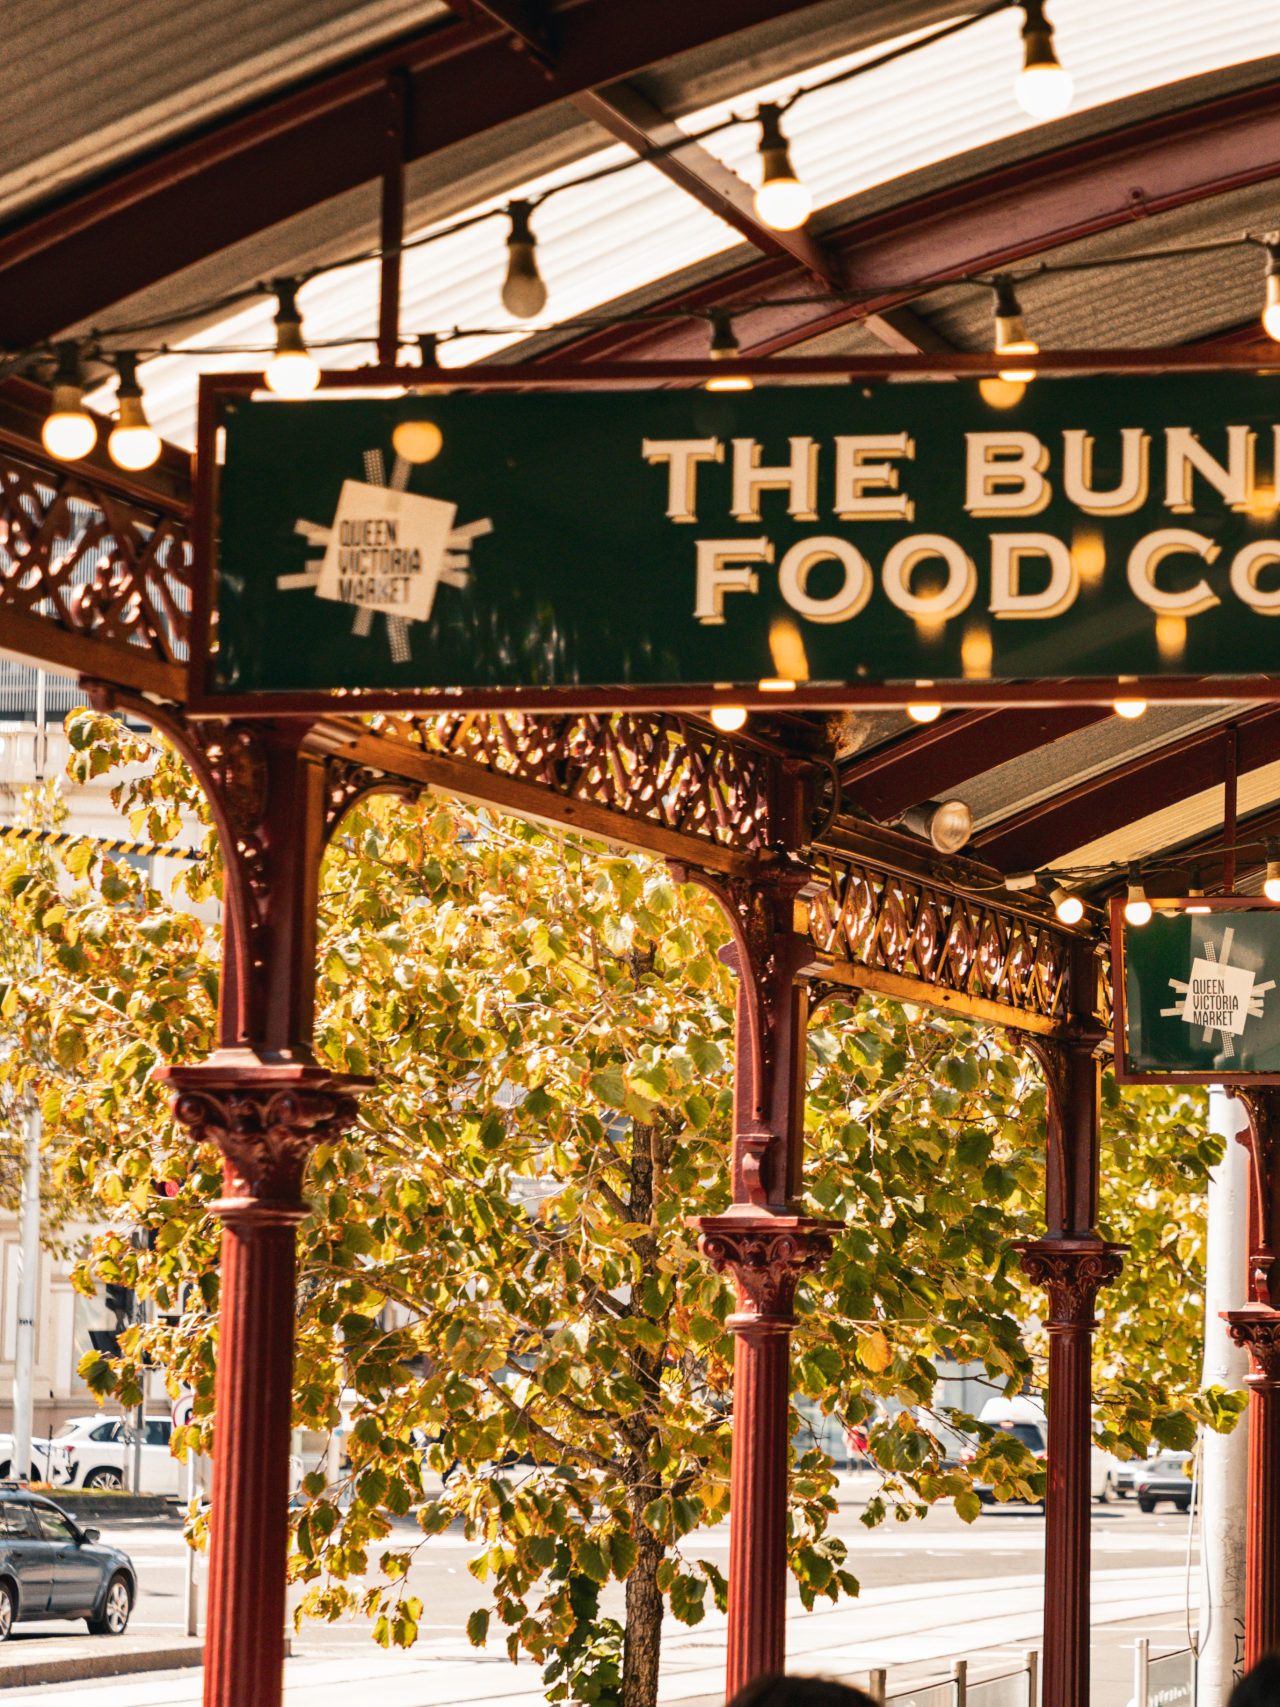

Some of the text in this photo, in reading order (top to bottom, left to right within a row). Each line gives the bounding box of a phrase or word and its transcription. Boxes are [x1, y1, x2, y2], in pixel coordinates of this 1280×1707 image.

[642, 431, 916, 524] THE
[339, 519, 399, 547] QUEEN
[337, 548, 423, 576] VICTORIA
[337, 577, 411, 604] MARKET
[692, 532, 1080, 624] FOOD
[1192, 980, 1225, 995] QUEEN
[1193, 995, 1239, 1010] VICTORIA
[1193, 1011, 1234, 1026] MARKET
